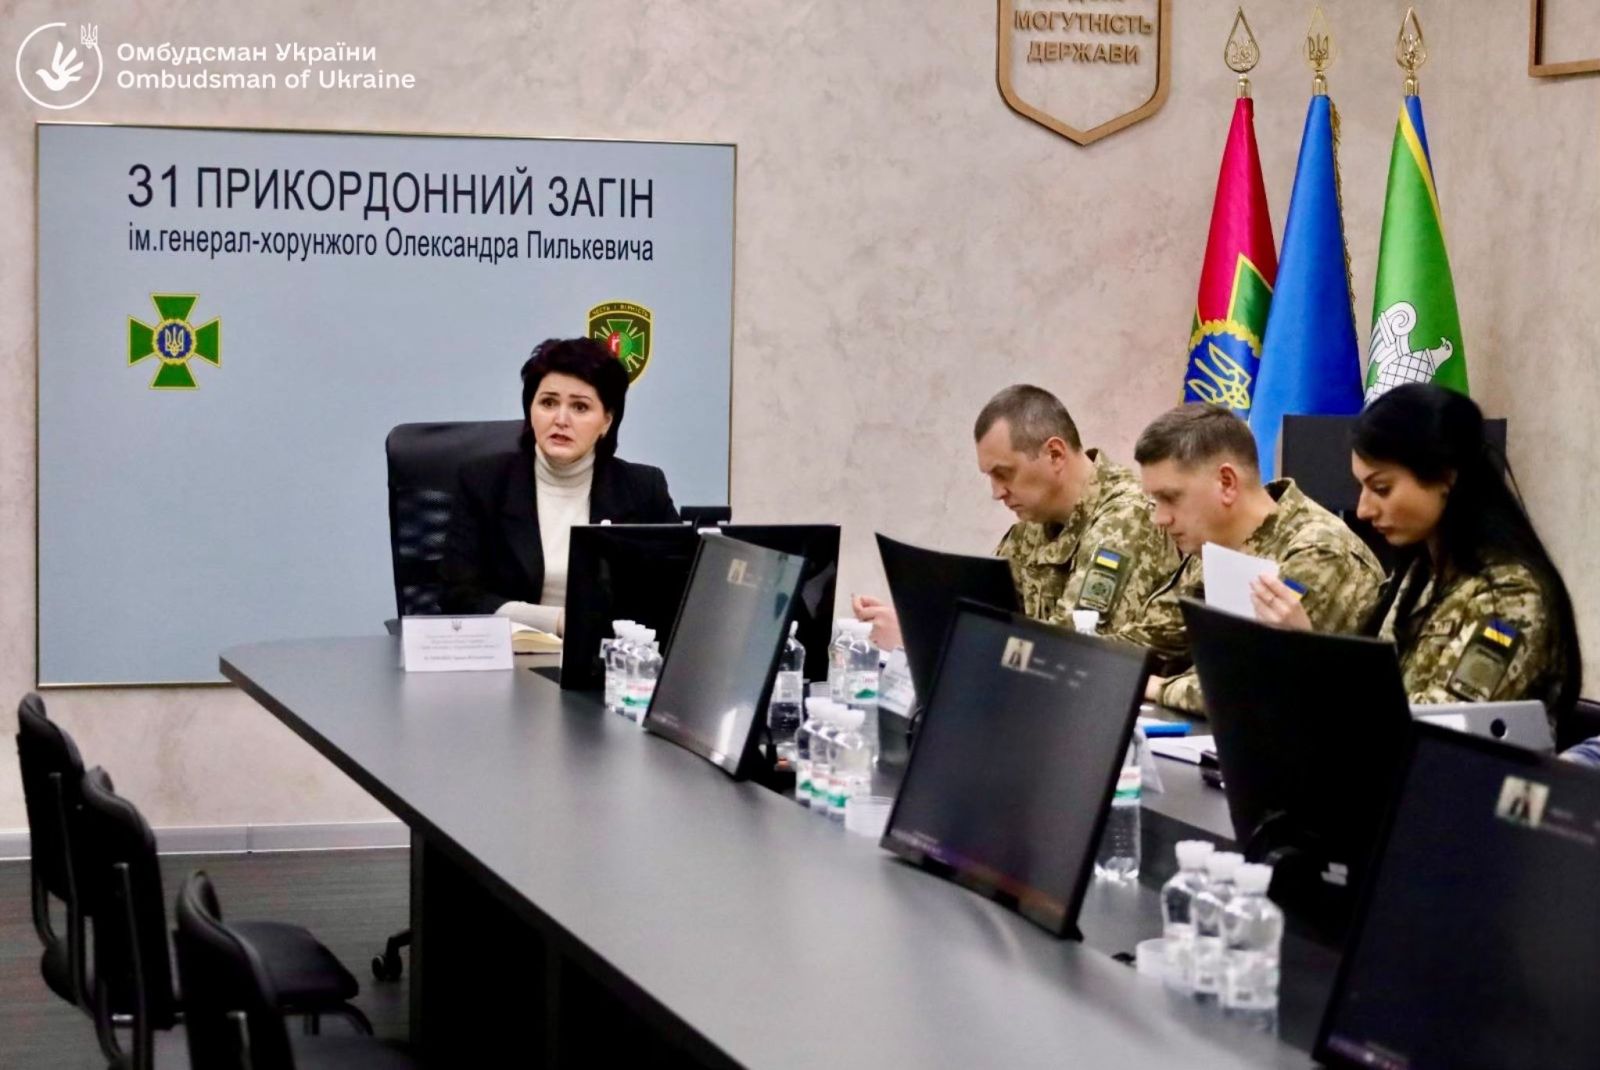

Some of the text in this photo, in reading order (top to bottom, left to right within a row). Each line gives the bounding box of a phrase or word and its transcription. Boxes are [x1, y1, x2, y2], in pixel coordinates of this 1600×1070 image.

[1014, 10, 1153, 35] МОГУТНІСТЬ
[1026, 41, 1140, 64] ДЕРЖАВИ
[128, 163, 653, 221] 31 ПРИКОРДОННИЙ ЗАГІН
[385, 226, 519, 265] Олександра
[527, 230, 654, 261] Пилькевича
